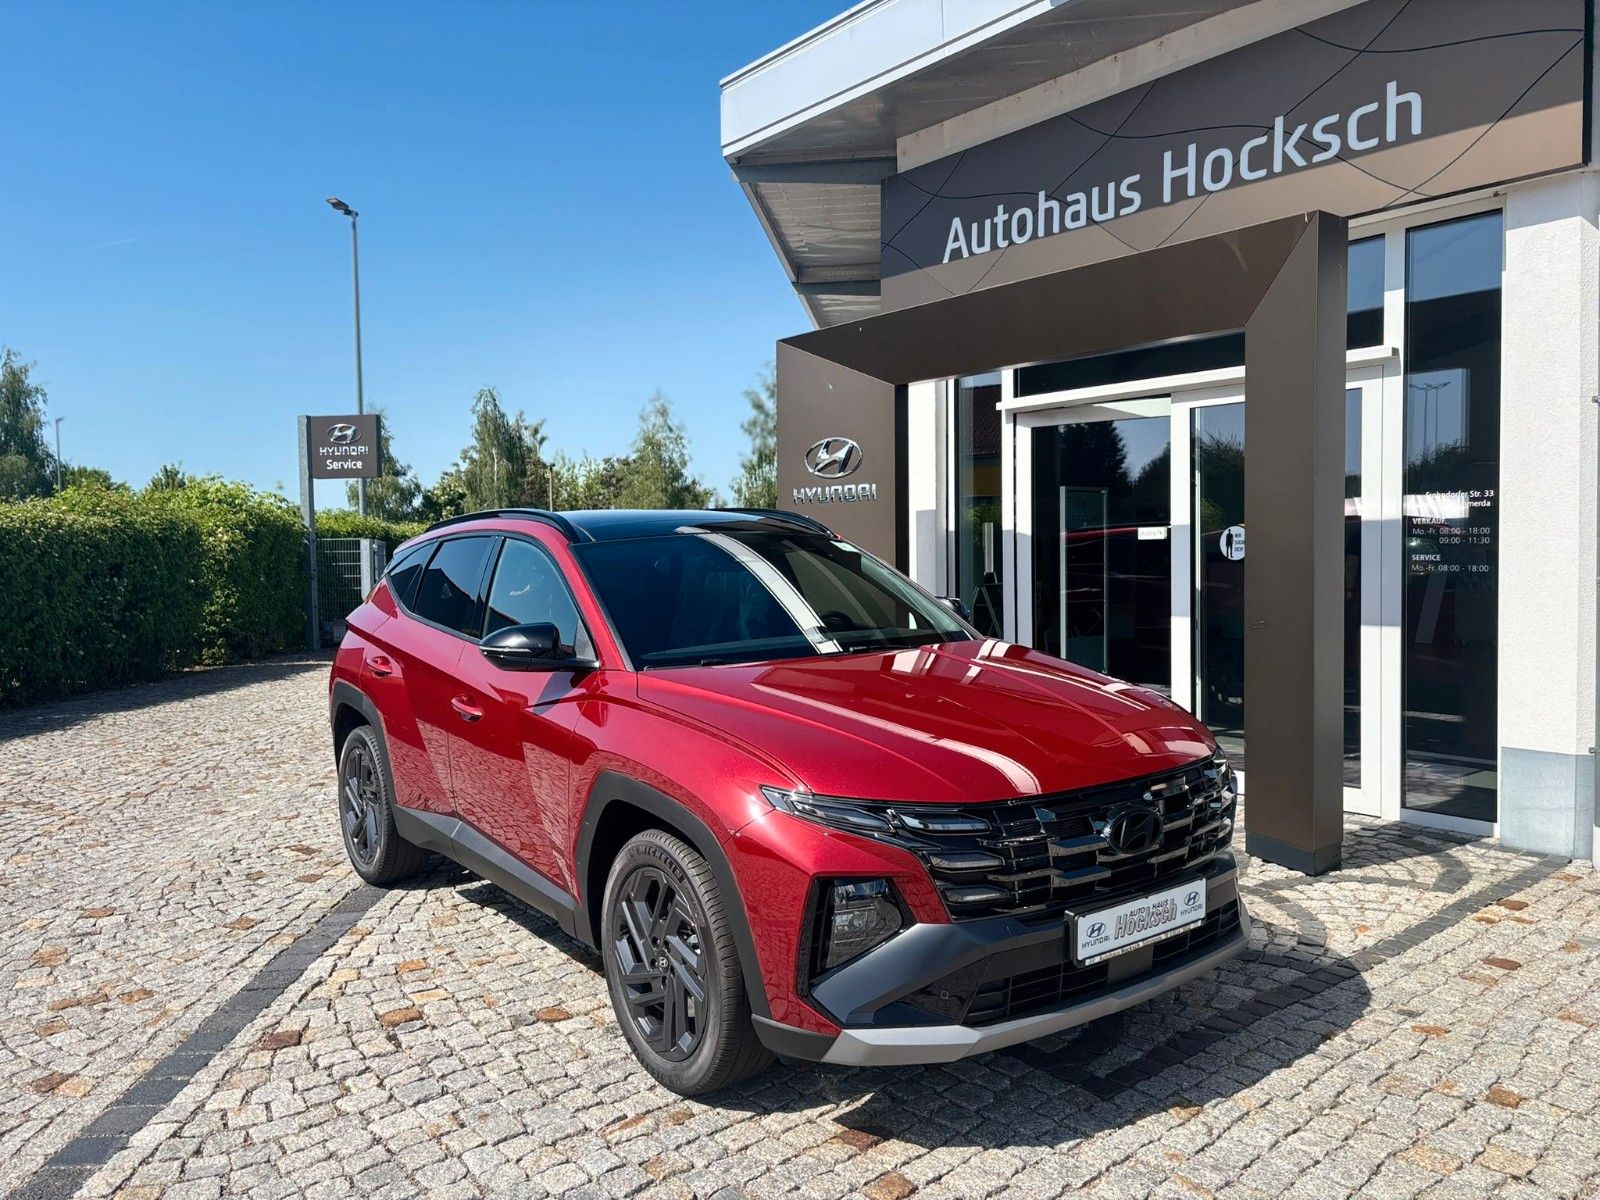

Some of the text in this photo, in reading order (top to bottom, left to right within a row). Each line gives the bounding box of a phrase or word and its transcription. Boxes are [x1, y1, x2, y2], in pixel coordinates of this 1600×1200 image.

[942, 81, 1423, 264] Autohaus Hocksch
[320, 446, 369, 455] HYUNDAI
[326, 459, 363, 470] Service
[793, 483, 877, 505] HYUNDAI
[1469, 490, 1482, 498] Str.
[1484, 489, 1494, 498] 33
[1468, 527, 1490, 535] 18:00
[1468, 536, 1490, 544] 11:30
[1438, 564, 1460, 572] 08:00
[1467, 564, 1490, 572] 18:00
[1129, 899, 1169, 918] AUTO HAUS
[1181, 903, 1203, 916] HYUNDAI
[1114, 898, 1178, 940] Hocksch
[1081, 935, 1110, 949] HYUNDAI
